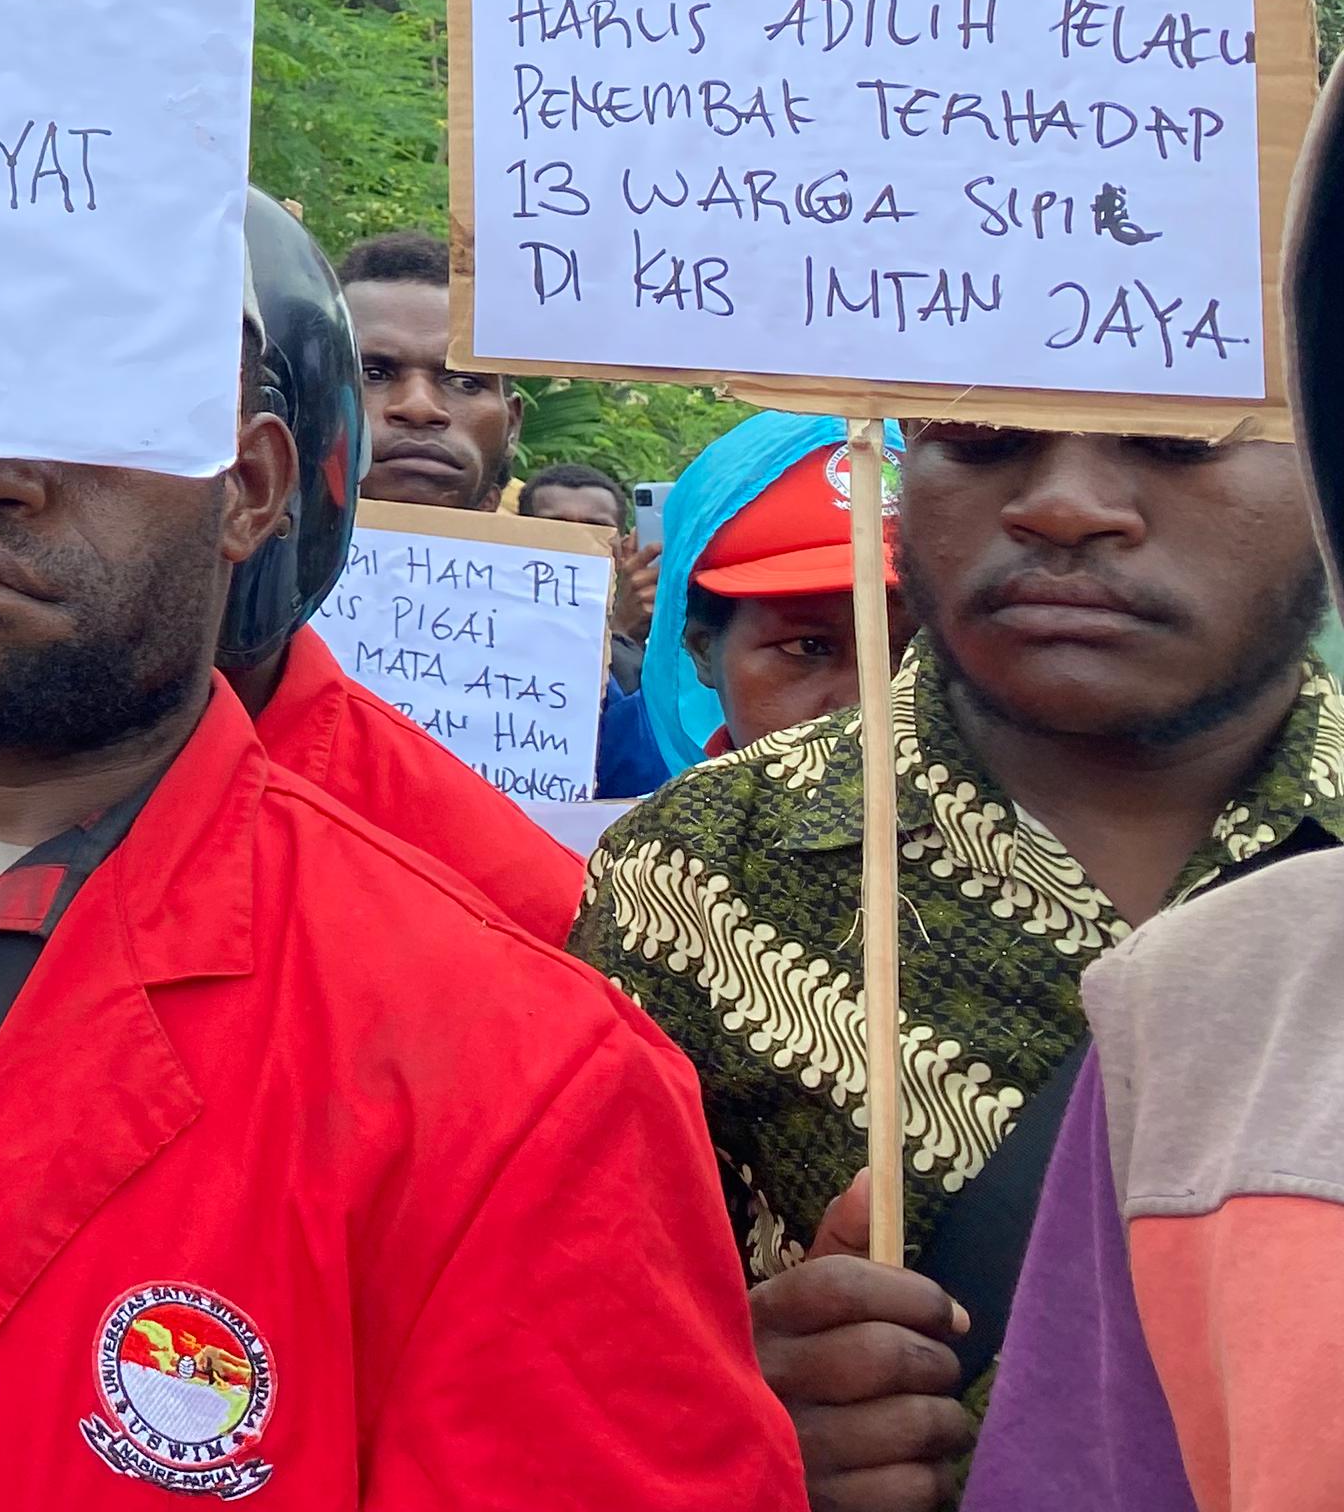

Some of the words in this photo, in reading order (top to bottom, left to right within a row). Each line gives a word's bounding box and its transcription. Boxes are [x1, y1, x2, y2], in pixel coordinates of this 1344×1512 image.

[511, 62, 817, 142] PENEMBAK
[857, 79, 1225, 162] TERHADAP
[506, 159, 591, 222] 13
[519, 239, 582, 307] DI
[634, 230, 735, 319] KAB
[406, 546, 493, 589] HAM
[355, 641, 448, 686] MATA
[463, 665, 567, 710] ATAS
